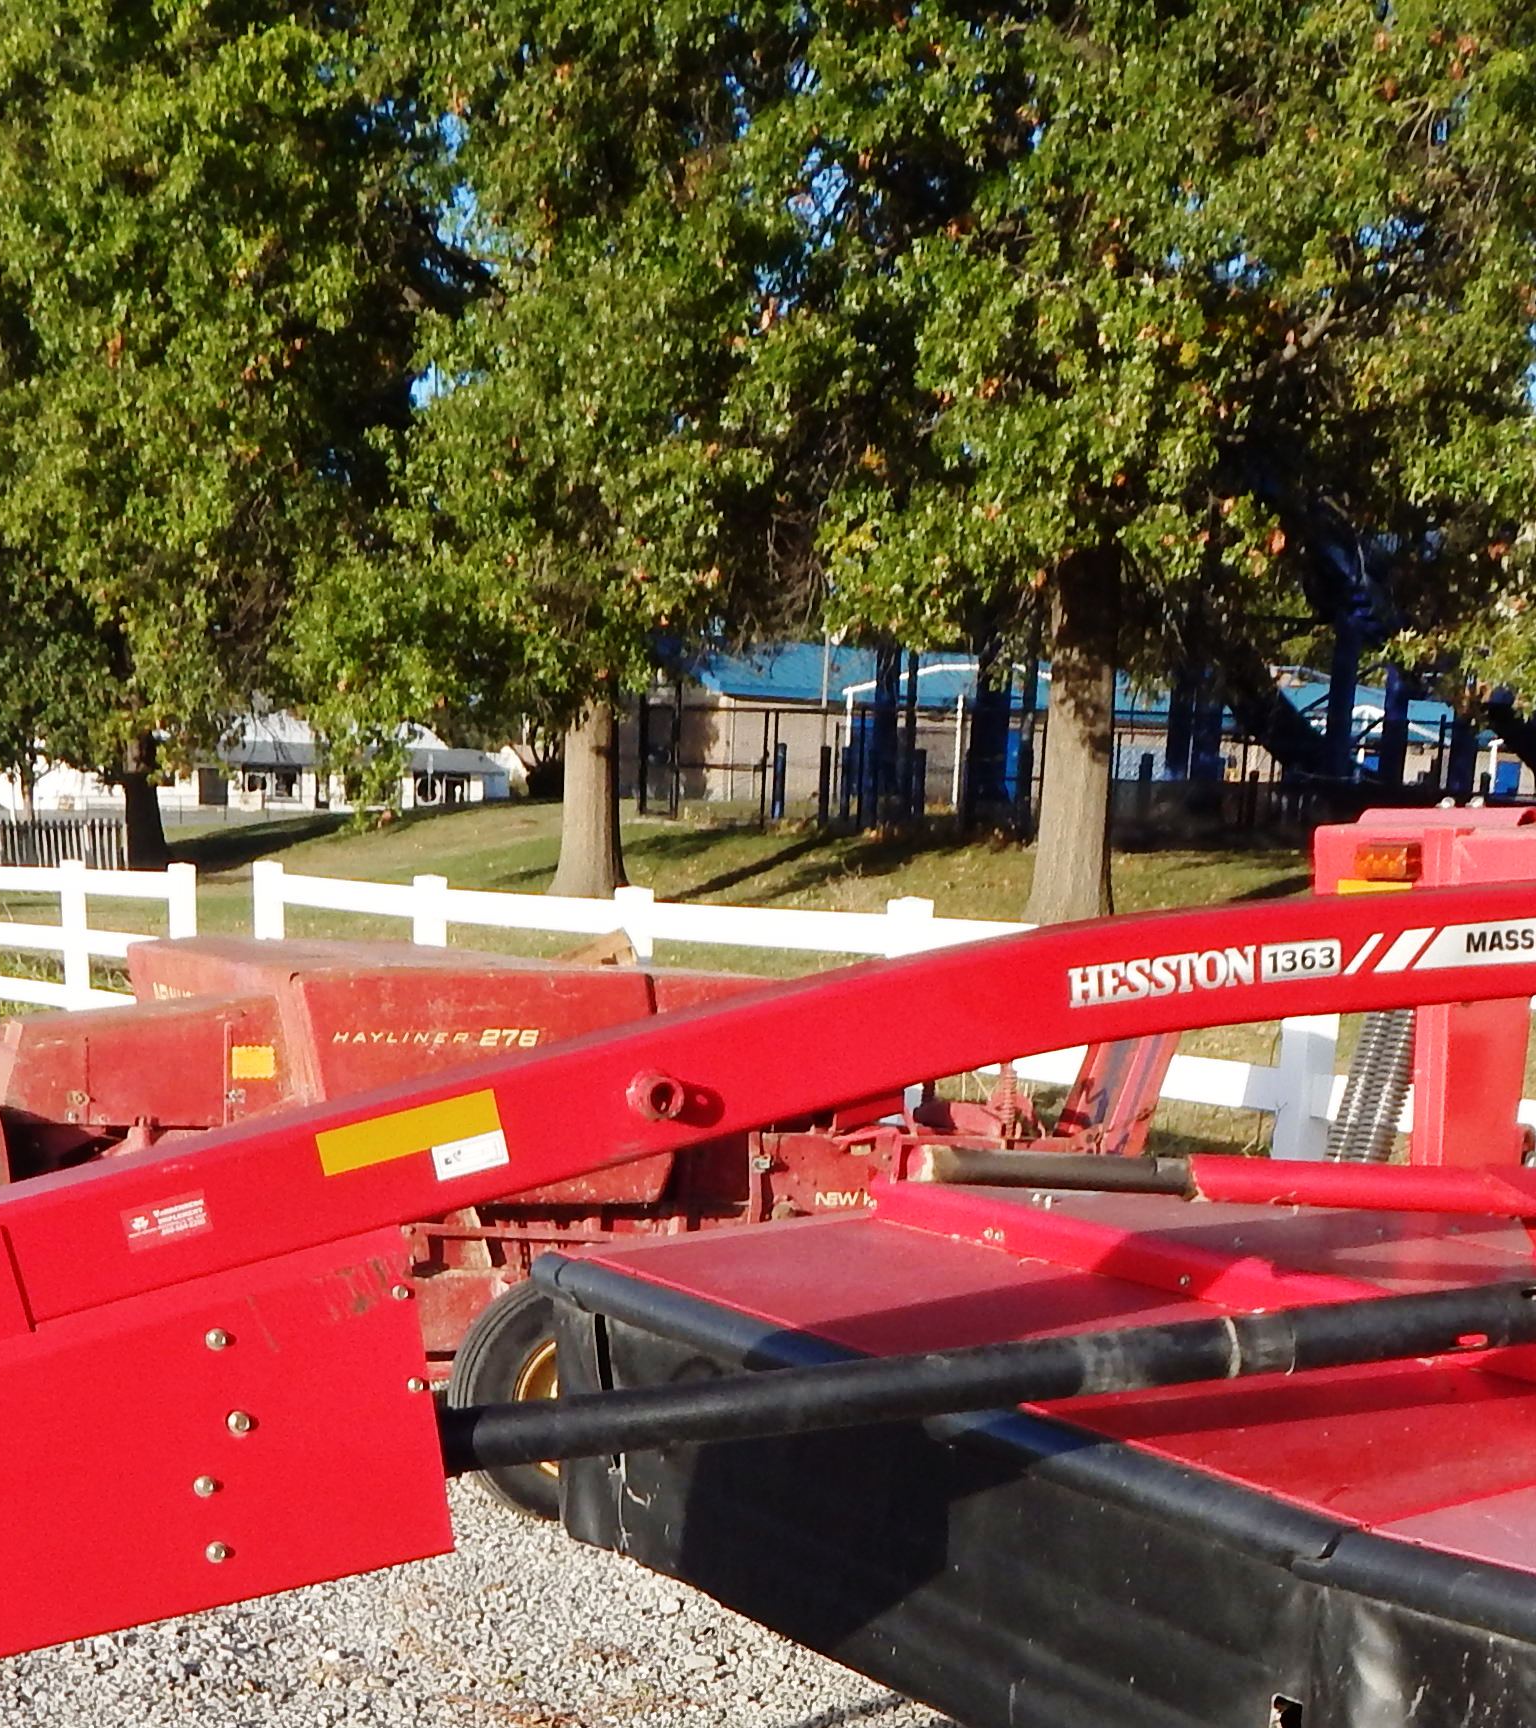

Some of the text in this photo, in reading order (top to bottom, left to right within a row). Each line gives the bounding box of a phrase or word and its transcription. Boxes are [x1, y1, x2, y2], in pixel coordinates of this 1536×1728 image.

[1068, 945, 1336, 1008] HESSTON 1363
[332, 1031, 469, 1044] HAYLINER
[815, 1191, 858, 1206] NEW
